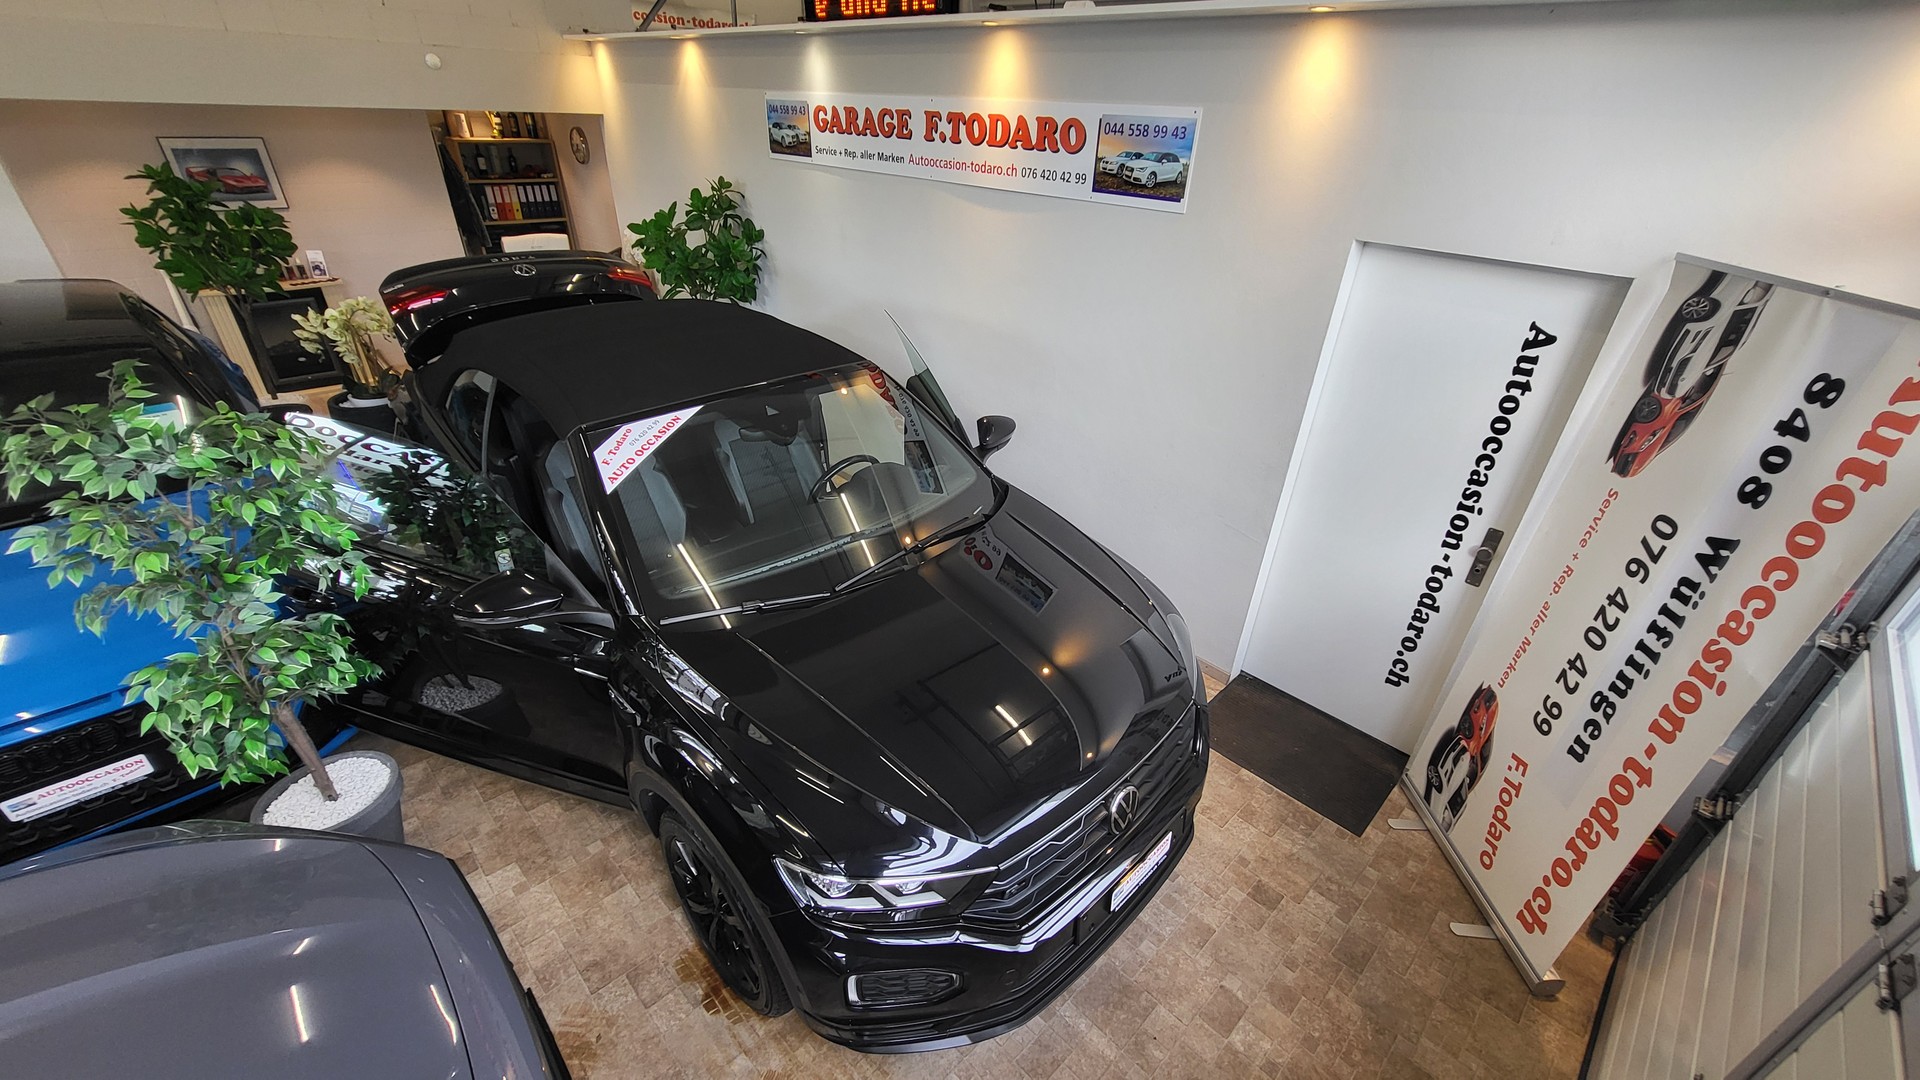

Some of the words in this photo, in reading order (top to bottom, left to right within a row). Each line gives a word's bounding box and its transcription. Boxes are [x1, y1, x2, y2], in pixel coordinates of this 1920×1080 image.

[768, 104, 779, 114] 044
[780, 104, 790, 115] 558
[791, 105, 798, 115] 99
[798, 106, 806, 116] 43
[813, 105, 913, 140] GARAGE
[923, 110, 1087, 155] F.TODARO
[1104, 122, 1125, 136] 044
[1128, 123, 1150, 138] 558
[1153, 125, 1168, 139] 99
[1171, 126, 1187, 140] 43
[815, 145, 837, 157] Service
[844, 148, 859, 160] Rep.
[860, 150, 875, 161] aller
[877, 153, 905, 164] Marken
[908, 153, 1018, 177] Autooccasion-todaro.ch
[1021, 167, 1038, 179] 076
[1040, 169, 1058, 182] 420
[1060, 171, 1072, 183] 42
[1075, 173, 1087, 185] 99
[607, 428, 632, 456] Todaro
[607, 457, 636, 484] AUTO
[634, 415, 682, 457] OCCASION
[1737, 372, 1846, 509] 8408
[1385, 321, 1557, 687] Autooccasion-todaro.ch
[1578, 488, 1619, 550] Service
[1624, 514, 1679, 586] 076
[1550, 566, 1575, 597] Rep.
[1529, 600, 1552, 635] aller
[1583, 586, 1630, 651] 420
[1498, 635, 1532, 688] Marken
[1567, 535, 1741, 764] Wülflingen
[1555, 653, 1589, 697] 42
[1533, 694, 1563, 736] 99
[37, 758, 144, 800] AUTOOCCASION
